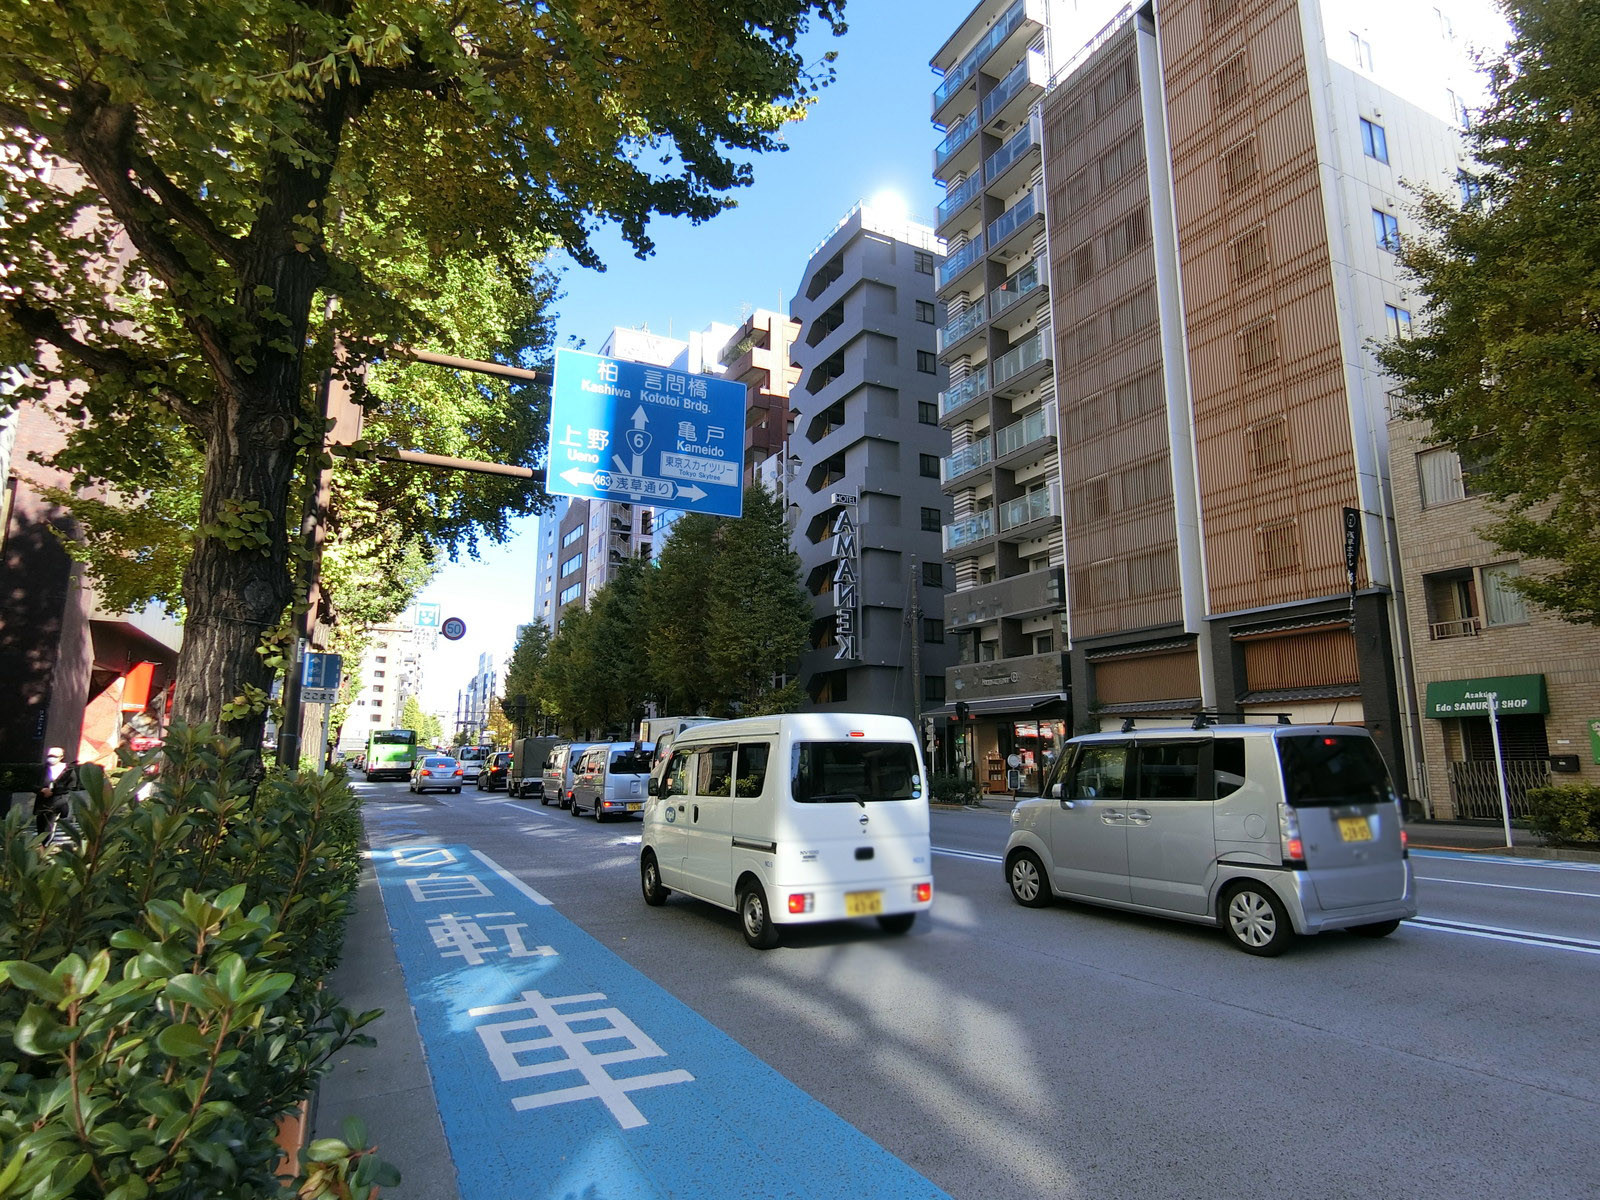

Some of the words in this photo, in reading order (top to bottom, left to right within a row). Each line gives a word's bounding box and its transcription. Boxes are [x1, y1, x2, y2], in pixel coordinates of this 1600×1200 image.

[597, 360, 618, 382] 柏
[581, 379, 631, 398] Kashiwa
[644, 369, 708, 399] 言問橋
[640, 389, 680, 407] Kototoi
[683, 398, 711, 414] Brdg.
[559, 424, 609, 451] 上野
[633, 433, 644, 448] 6
[677, 421, 726, 445] 亀戸
[567, 448, 599, 464] Ueno
[676, 440, 724, 457] Kameido
[665, 455, 734, 474] 東京スカイツリー
[594, 475, 612, 486] 463
[679, 469, 697, 478] Tokyo
[698, 472, 721, 481] Skytree
[615, 477, 670, 496] 浅草通り
[836, 494, 857, 504] HOTEL
[447, 623, 462, 635] 50
[303, 691, 335, 702] ここまで
[1435, 703, 1452, 712] Edo
[1454, 700, 1499, 711] SAMURI
[1501, 699, 1528, 708] SHOP
